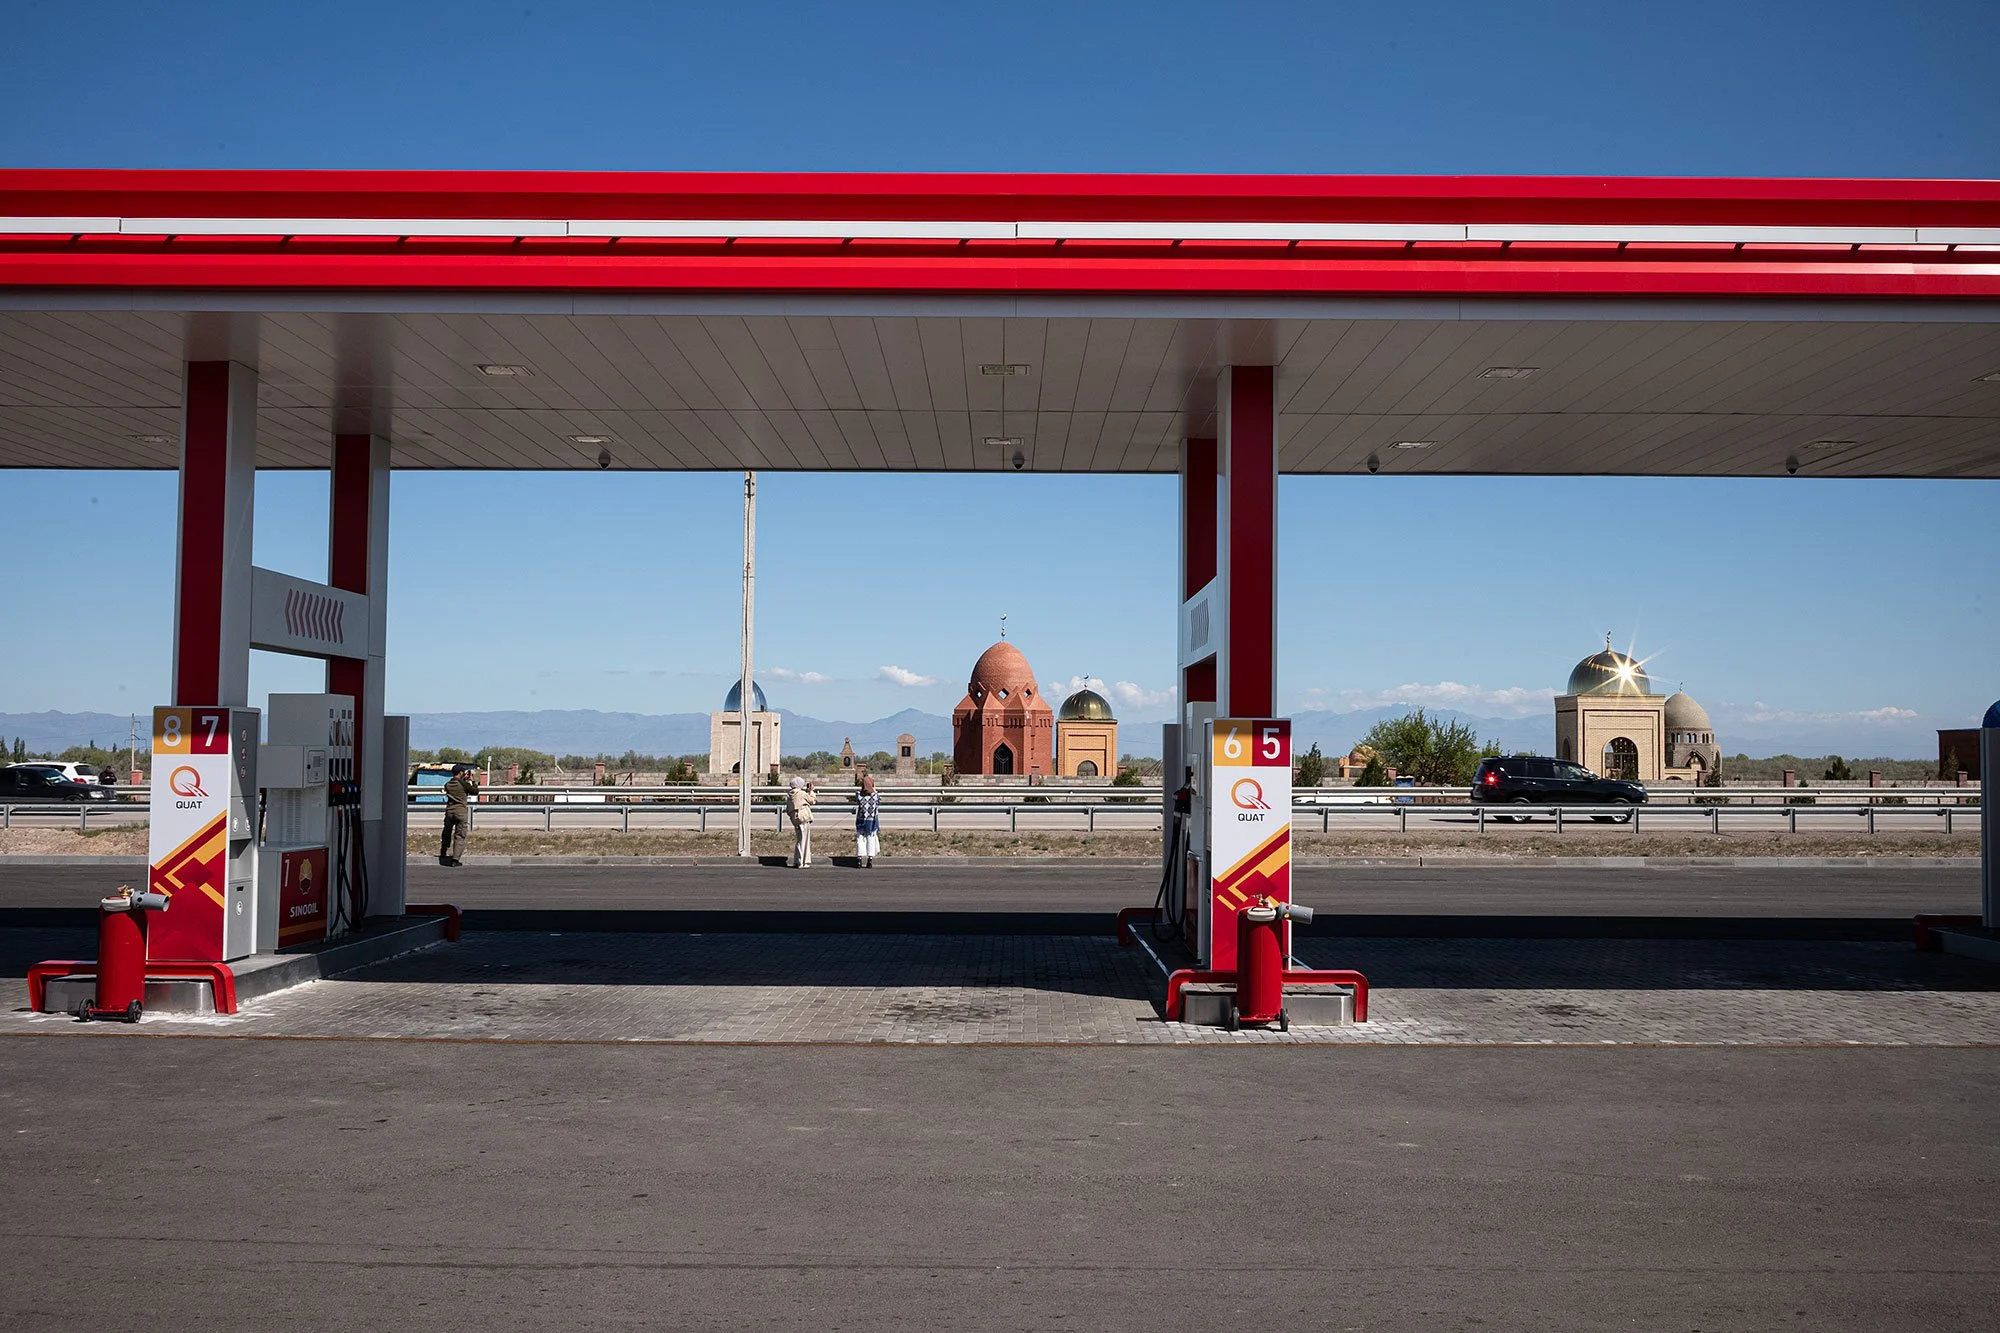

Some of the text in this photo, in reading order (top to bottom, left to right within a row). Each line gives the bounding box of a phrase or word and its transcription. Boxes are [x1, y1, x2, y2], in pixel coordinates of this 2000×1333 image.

[162, 715, 219, 747] 8 7
[1223, 727, 1281, 760] 6 5
[175, 800, 203, 810] QUAT
[1237, 813, 1265, 822] QUAT
[289, 902, 319, 918] SINOOIL
